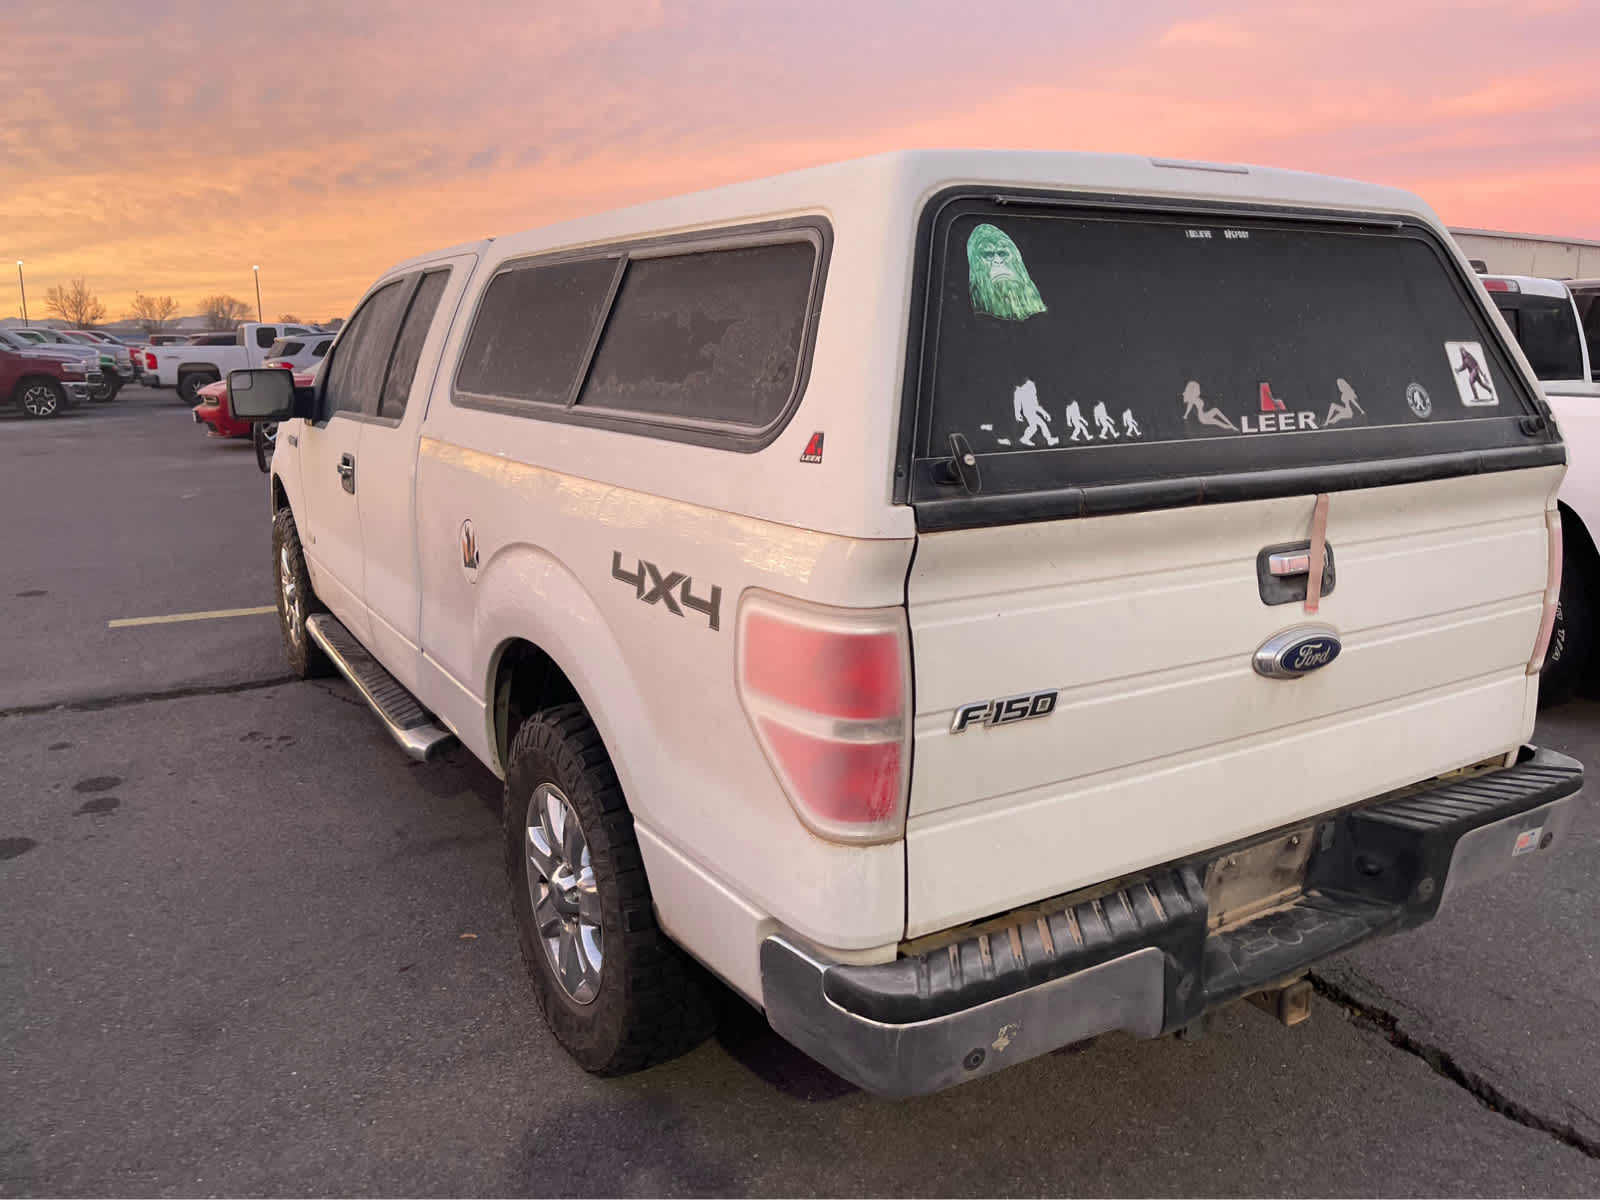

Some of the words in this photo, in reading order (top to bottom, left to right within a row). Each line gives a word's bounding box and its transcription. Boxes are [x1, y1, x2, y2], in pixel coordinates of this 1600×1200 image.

[1241, 411, 1319, 433] LEER
[1294, 643, 1331, 669] Ford
[951, 688, 1058, 734] F-150
